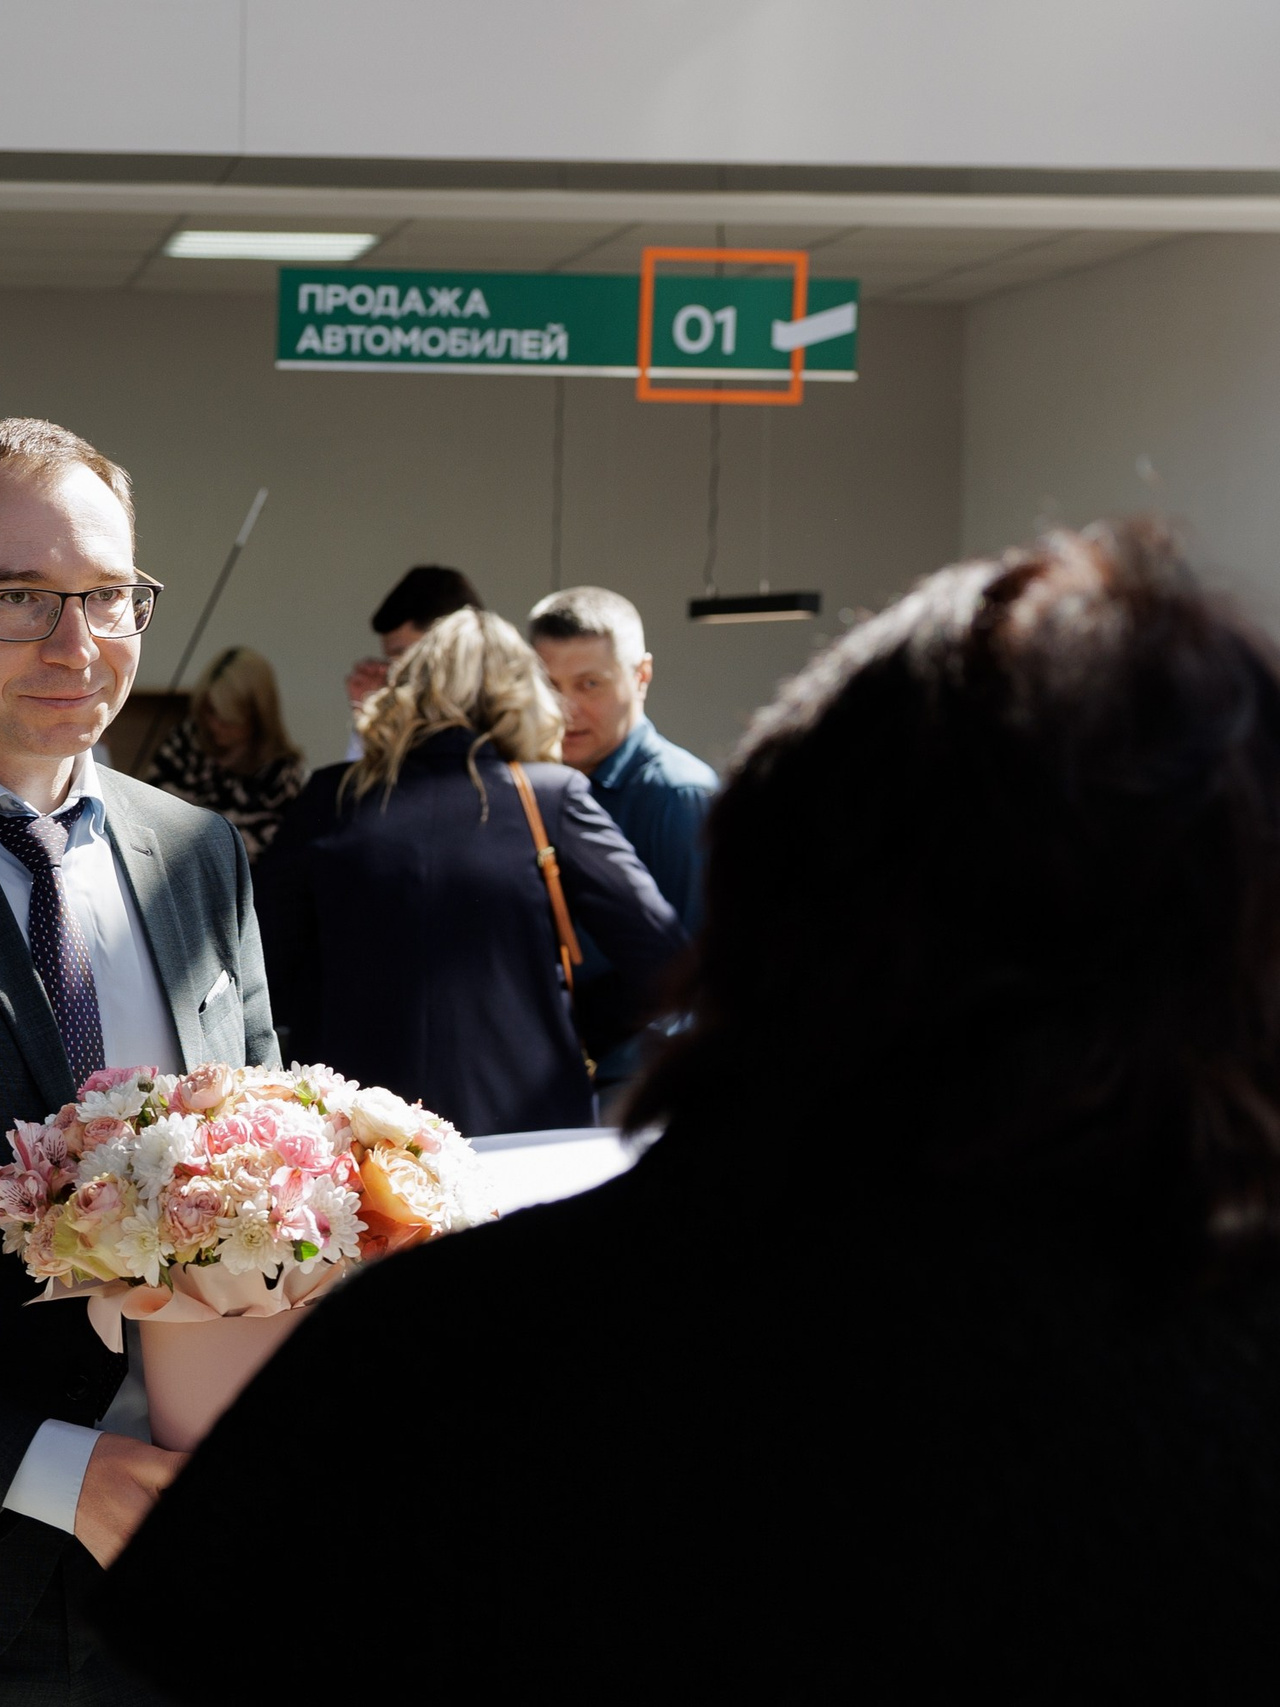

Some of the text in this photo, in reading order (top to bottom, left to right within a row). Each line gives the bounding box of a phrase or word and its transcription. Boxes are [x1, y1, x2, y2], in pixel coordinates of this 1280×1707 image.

[297, 283, 490, 318] ПРОДАЖА
[295, 322, 568, 361] АВТОМОБИЛЕЙ
[673, 304, 737, 355] 01
